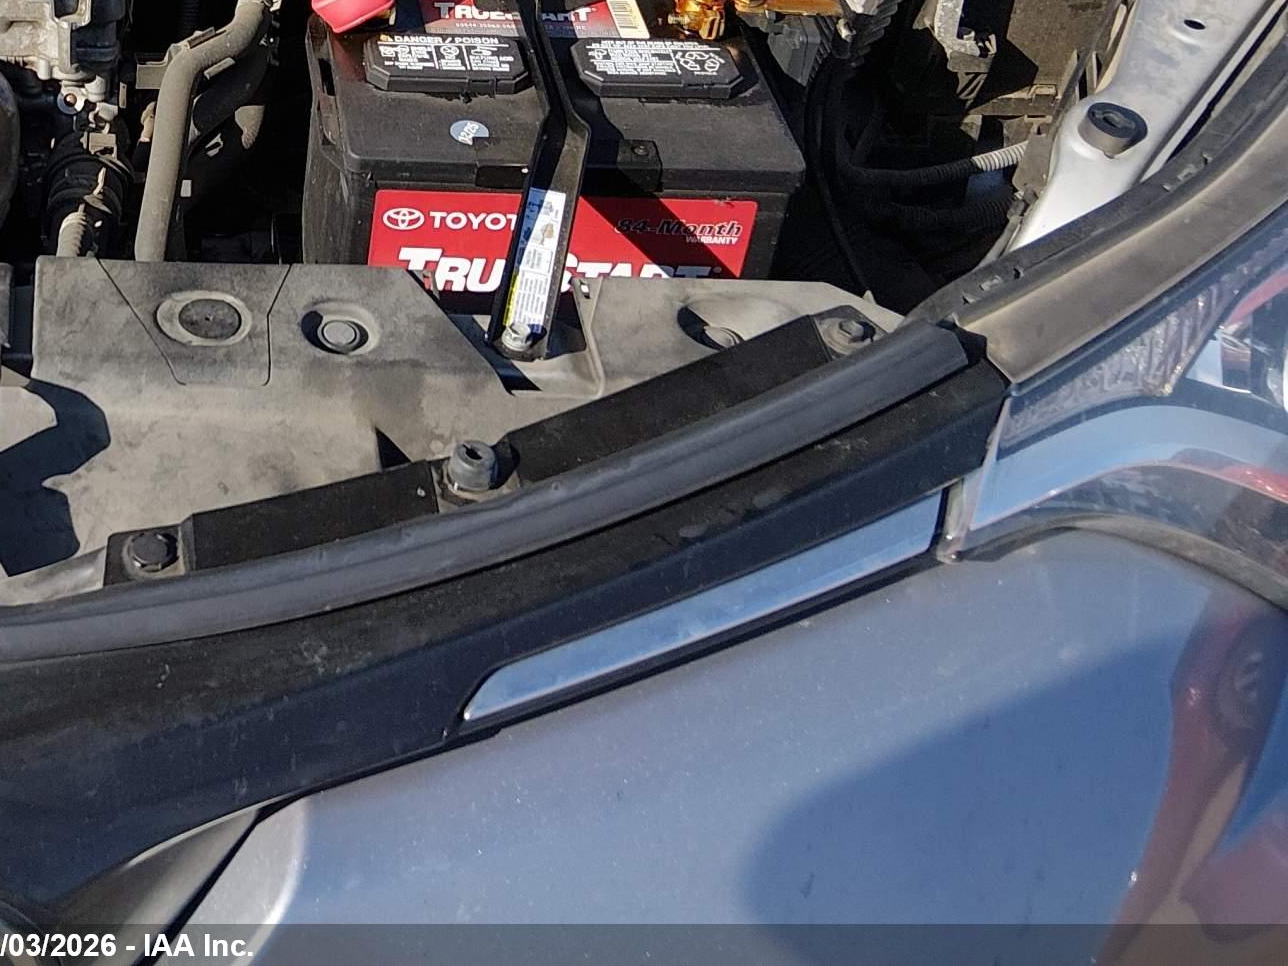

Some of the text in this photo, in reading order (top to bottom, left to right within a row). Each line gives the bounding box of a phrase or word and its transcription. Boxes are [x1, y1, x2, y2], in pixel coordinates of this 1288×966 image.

[454, 37, 500, 45] POISON
[429, 211, 518, 231] TOYOT
[615, 217, 743, 237] 84-Month
[685, 236, 739, 245] WARRANTY
